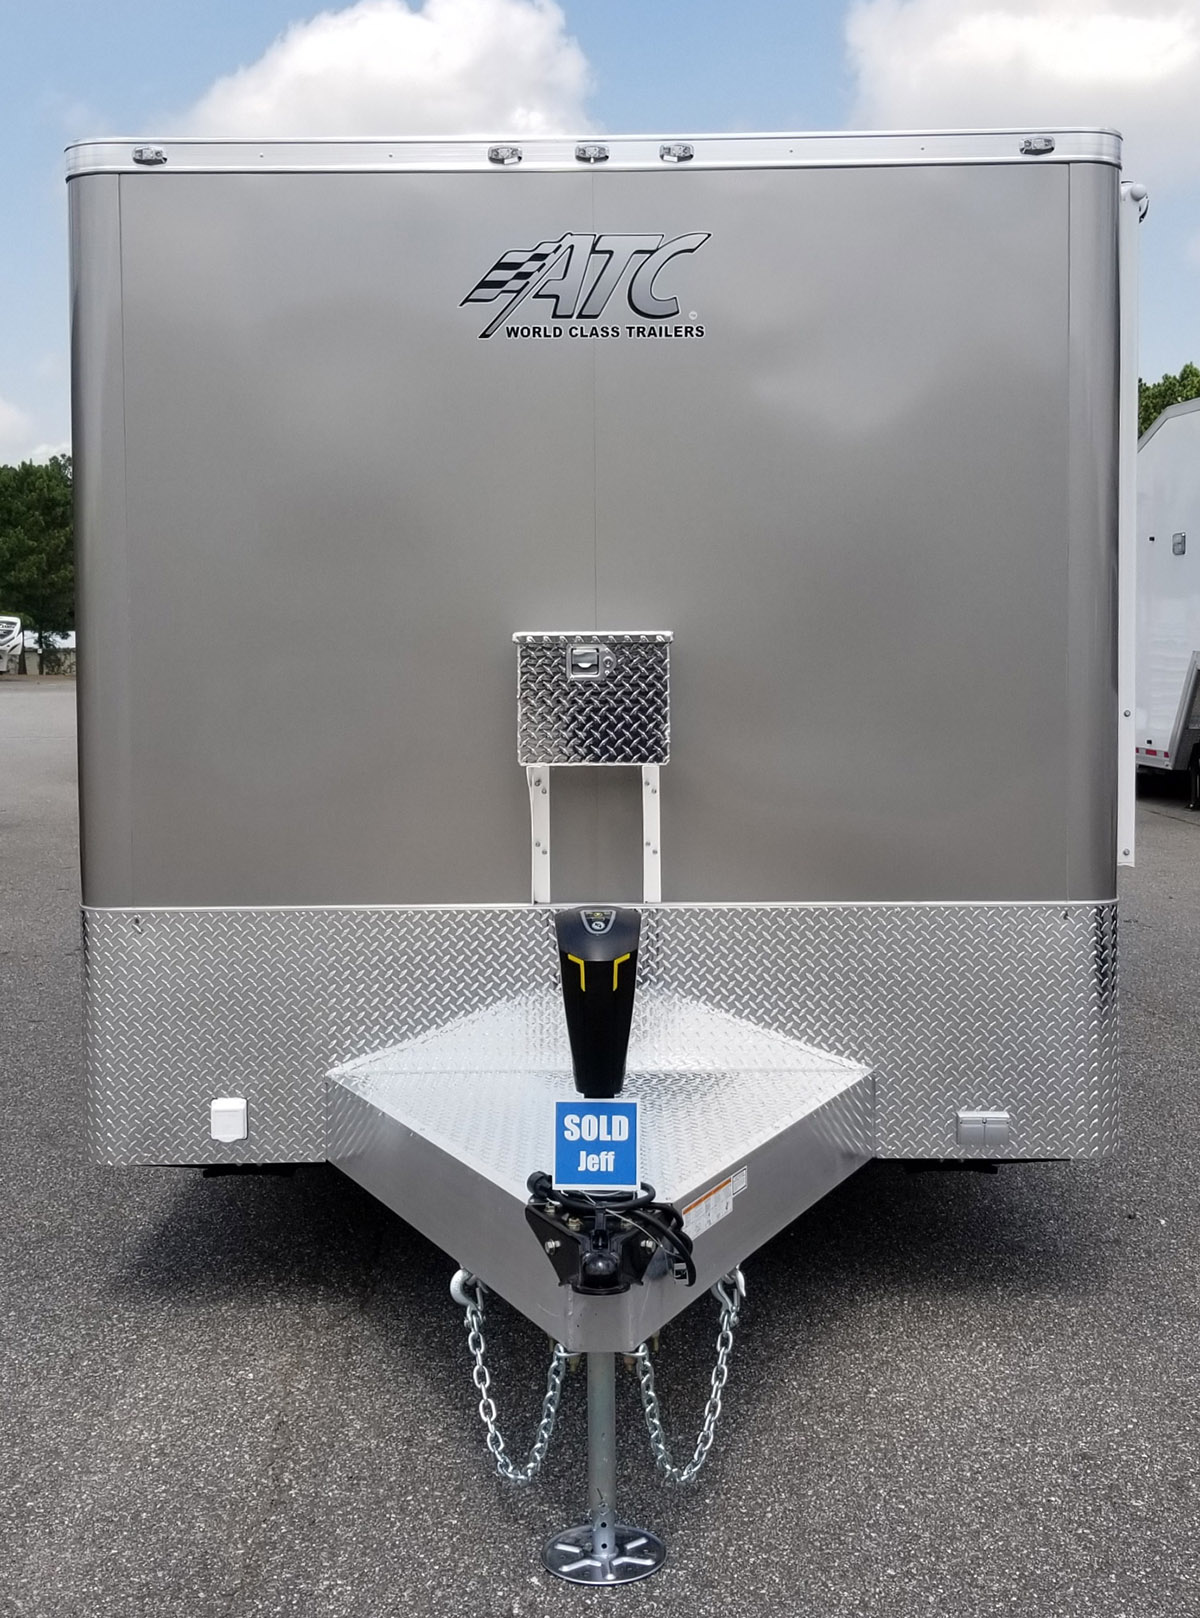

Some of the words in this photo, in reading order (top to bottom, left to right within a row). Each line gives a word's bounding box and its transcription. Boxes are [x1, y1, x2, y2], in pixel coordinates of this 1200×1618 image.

[532, 232, 711, 319] ATC
[506, 326, 562, 338] WORLD
[569, 326, 620, 338] CLASS
[626, 325, 705, 338] TRAILERS
[563, 1114, 629, 1141] SOLD
[578, 1151, 615, 1172] Jeff
